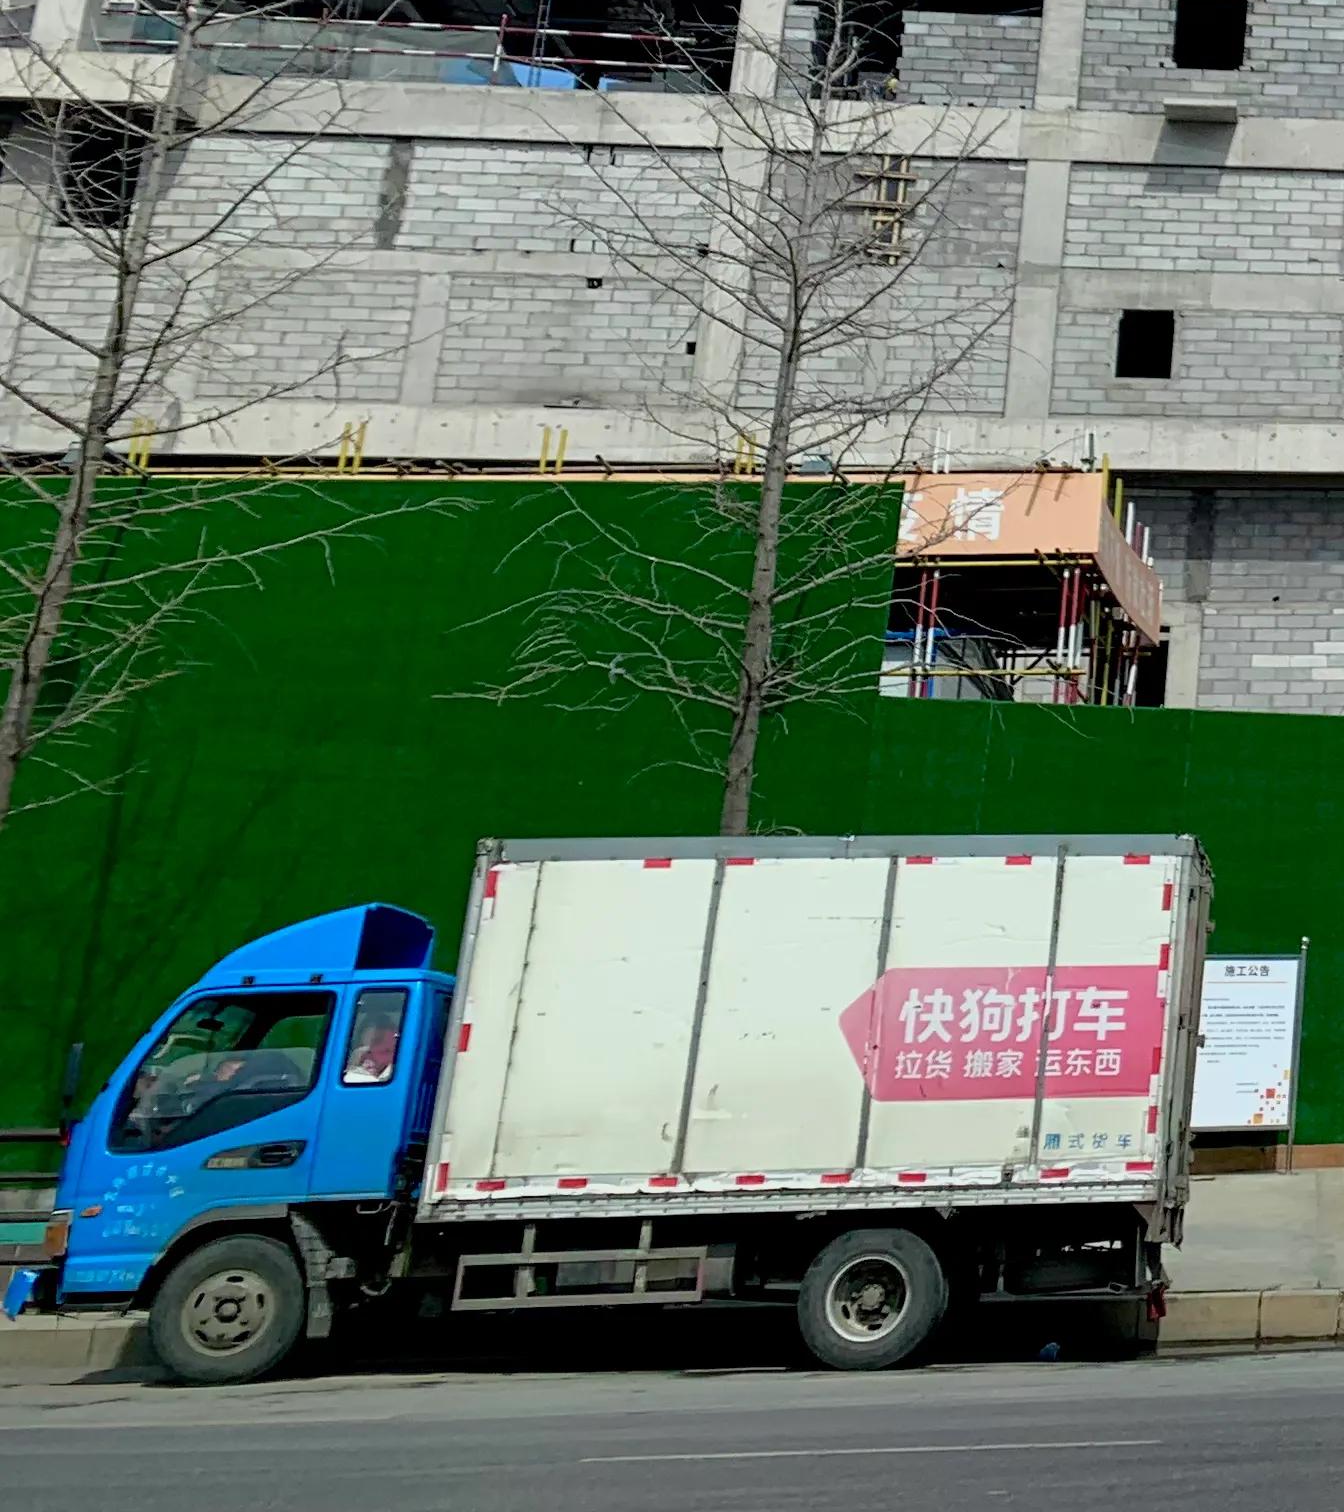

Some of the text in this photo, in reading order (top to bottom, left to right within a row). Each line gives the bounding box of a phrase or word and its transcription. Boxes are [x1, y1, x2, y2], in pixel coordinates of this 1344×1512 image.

[1224, 964, 1271, 977] 施工公告
[899, 987, 1130, 1044] 快狗打车
[895, 1048, 1123, 1080] 拉货 搬家 运东西
